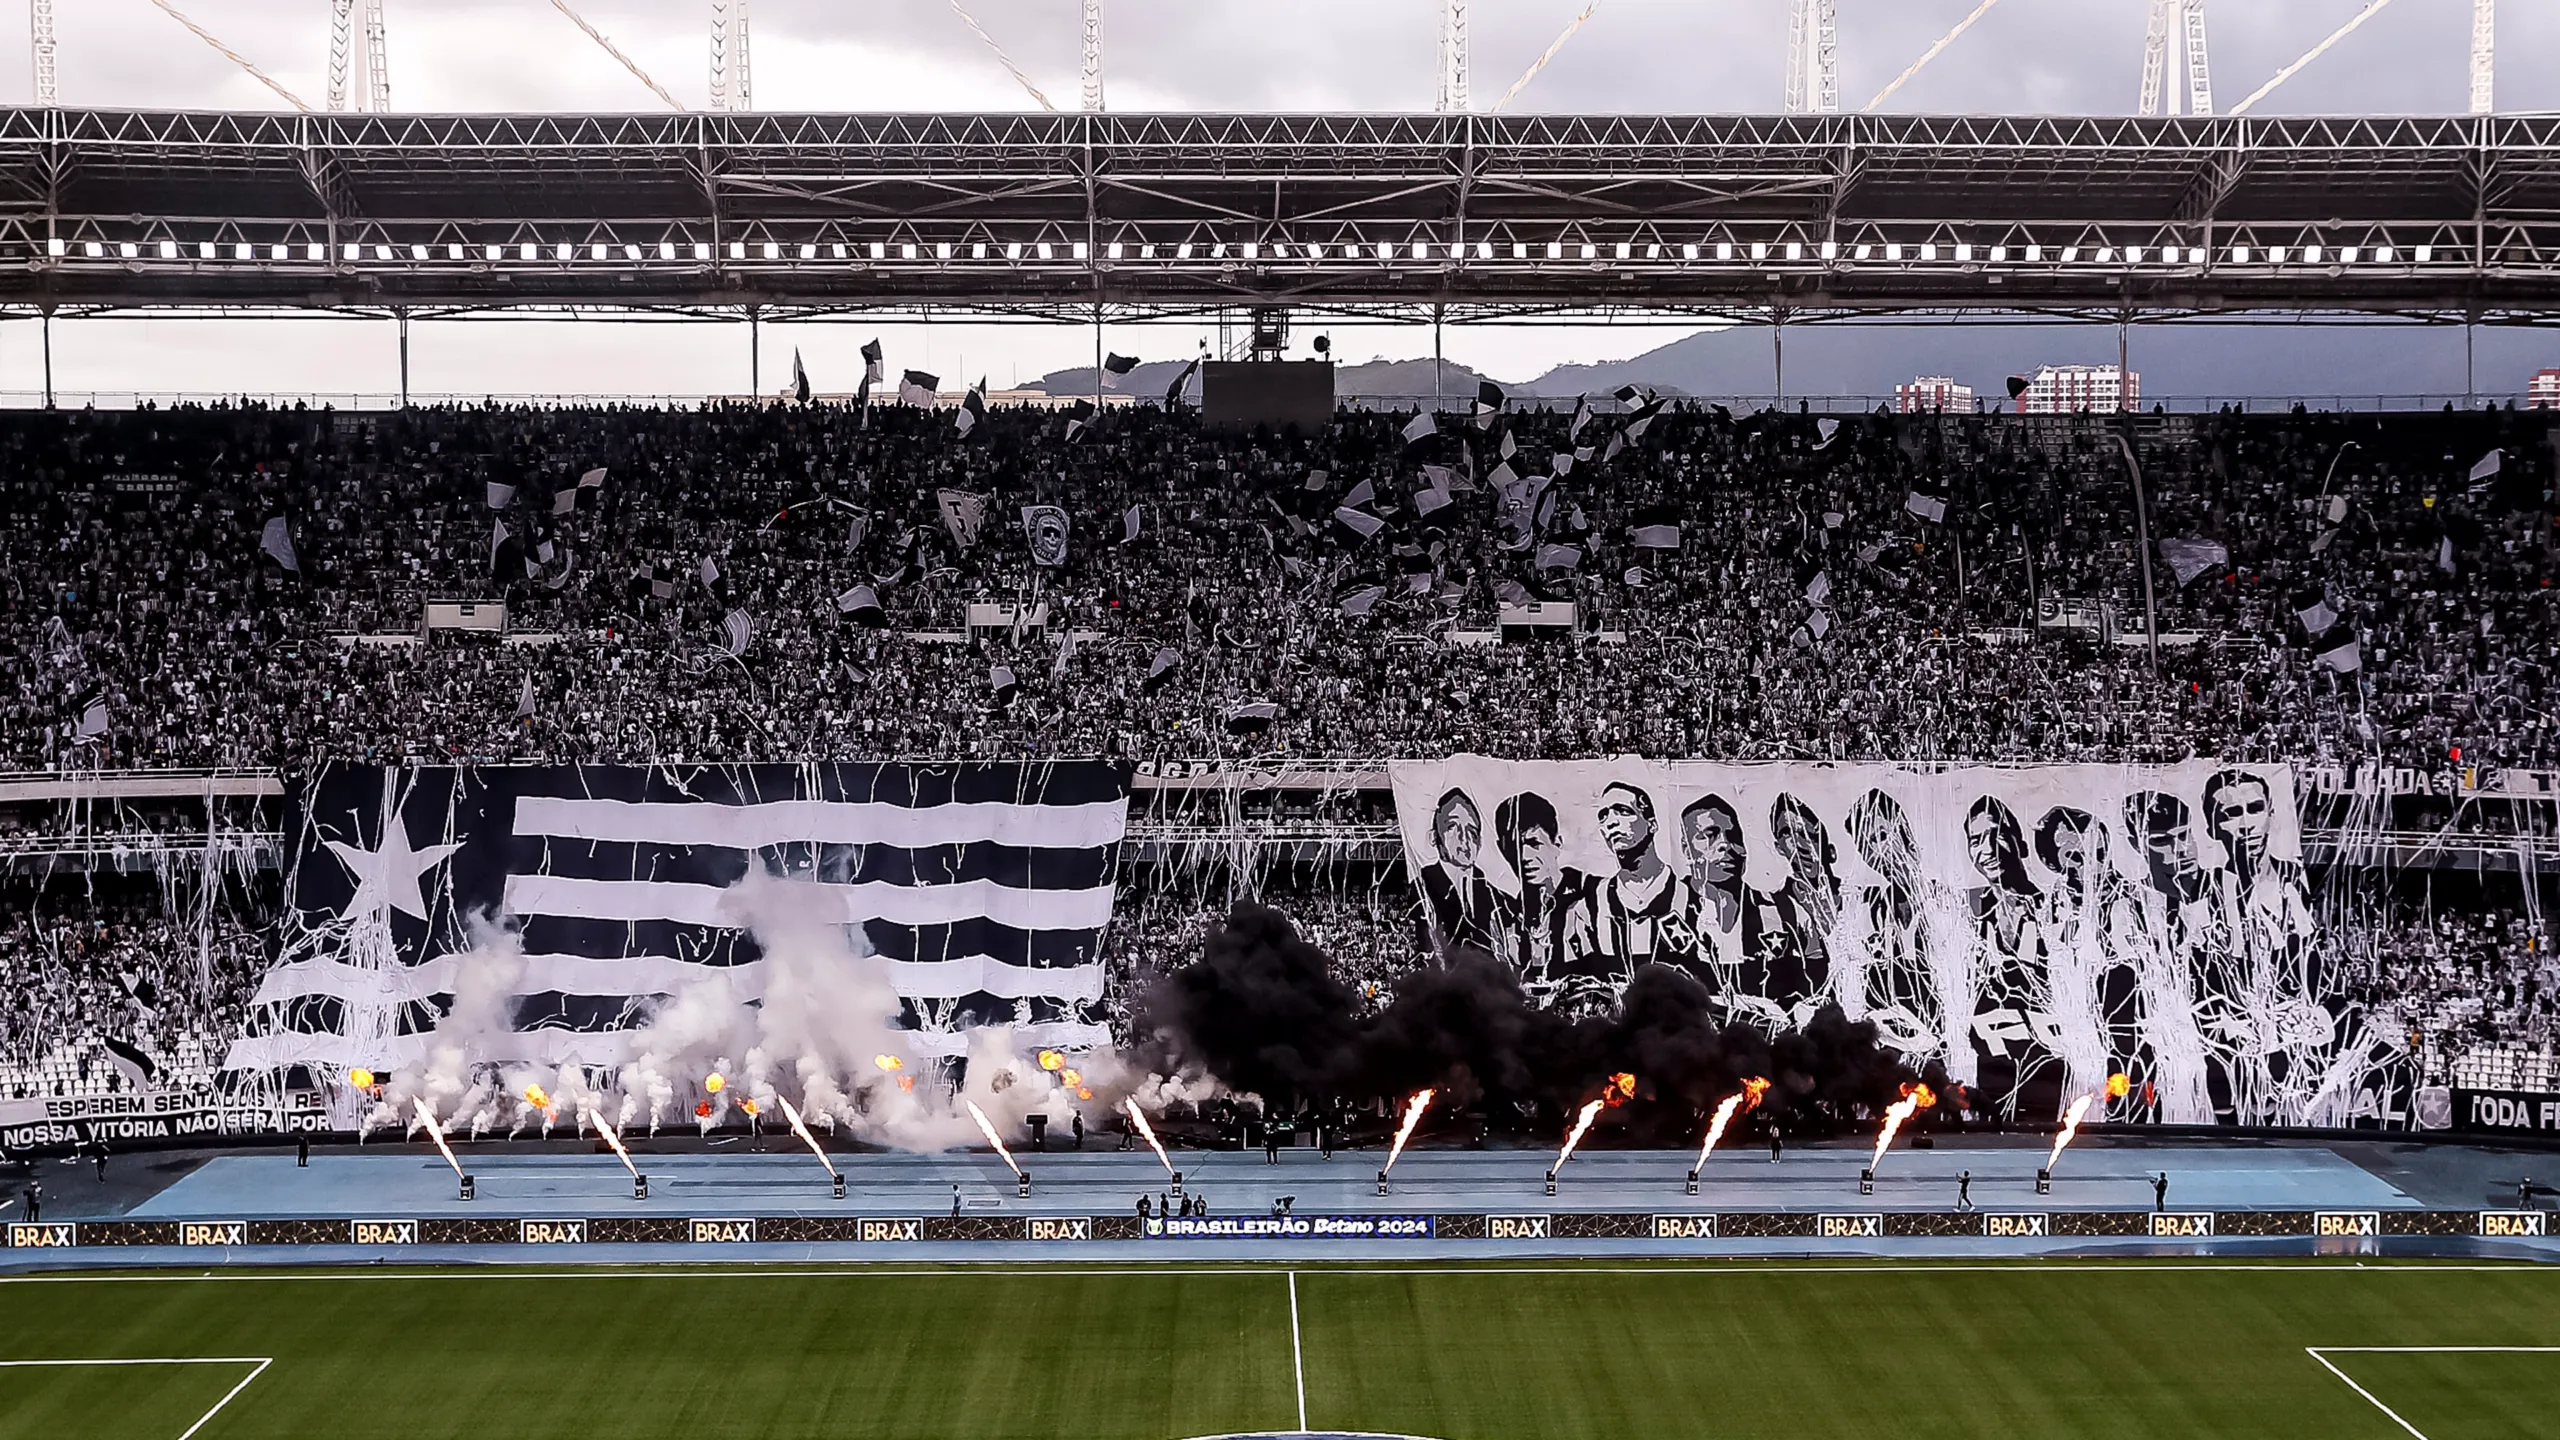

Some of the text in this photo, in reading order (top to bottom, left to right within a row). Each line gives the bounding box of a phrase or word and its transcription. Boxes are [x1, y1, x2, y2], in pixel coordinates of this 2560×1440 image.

[45, 1098, 145, 1119] ESPEREM
[2471, 1095, 2531, 1128] TODA
[4, 1125, 79, 1146] NOSSA
[86, 1117, 169, 1142] VITÓRIA
[176, 1112, 219, 1136] NÃO
[290, 1115, 330, 1132] POR
[357, 1224, 412, 1244] BRAX
[526, 1224, 581, 1243] BRAX
[695, 1223, 749, 1242] BRAX
[863, 1222, 918, 1241] BRAX
[1032, 1221, 1086, 1240] BRAX
[1166, 1215, 1427, 1235] BRASILEIRÃO Betano 2024
[1492, 1219, 1545, 1238] BRAX
[1658, 1219, 1711, 1237] BRAX
[1824, 1218, 1878, 1237] BRAX
[1990, 1217, 2042, 1236] BRAX
[2155, 1217, 2208, 1236] BRAX
[2320, 1216, 2373, 1236] BRAX
[2485, 1216, 2539, 1236] BRAX
[14, 1227, 69, 1247] BRAX
[186, 1225, 241, 1245] BRAX
